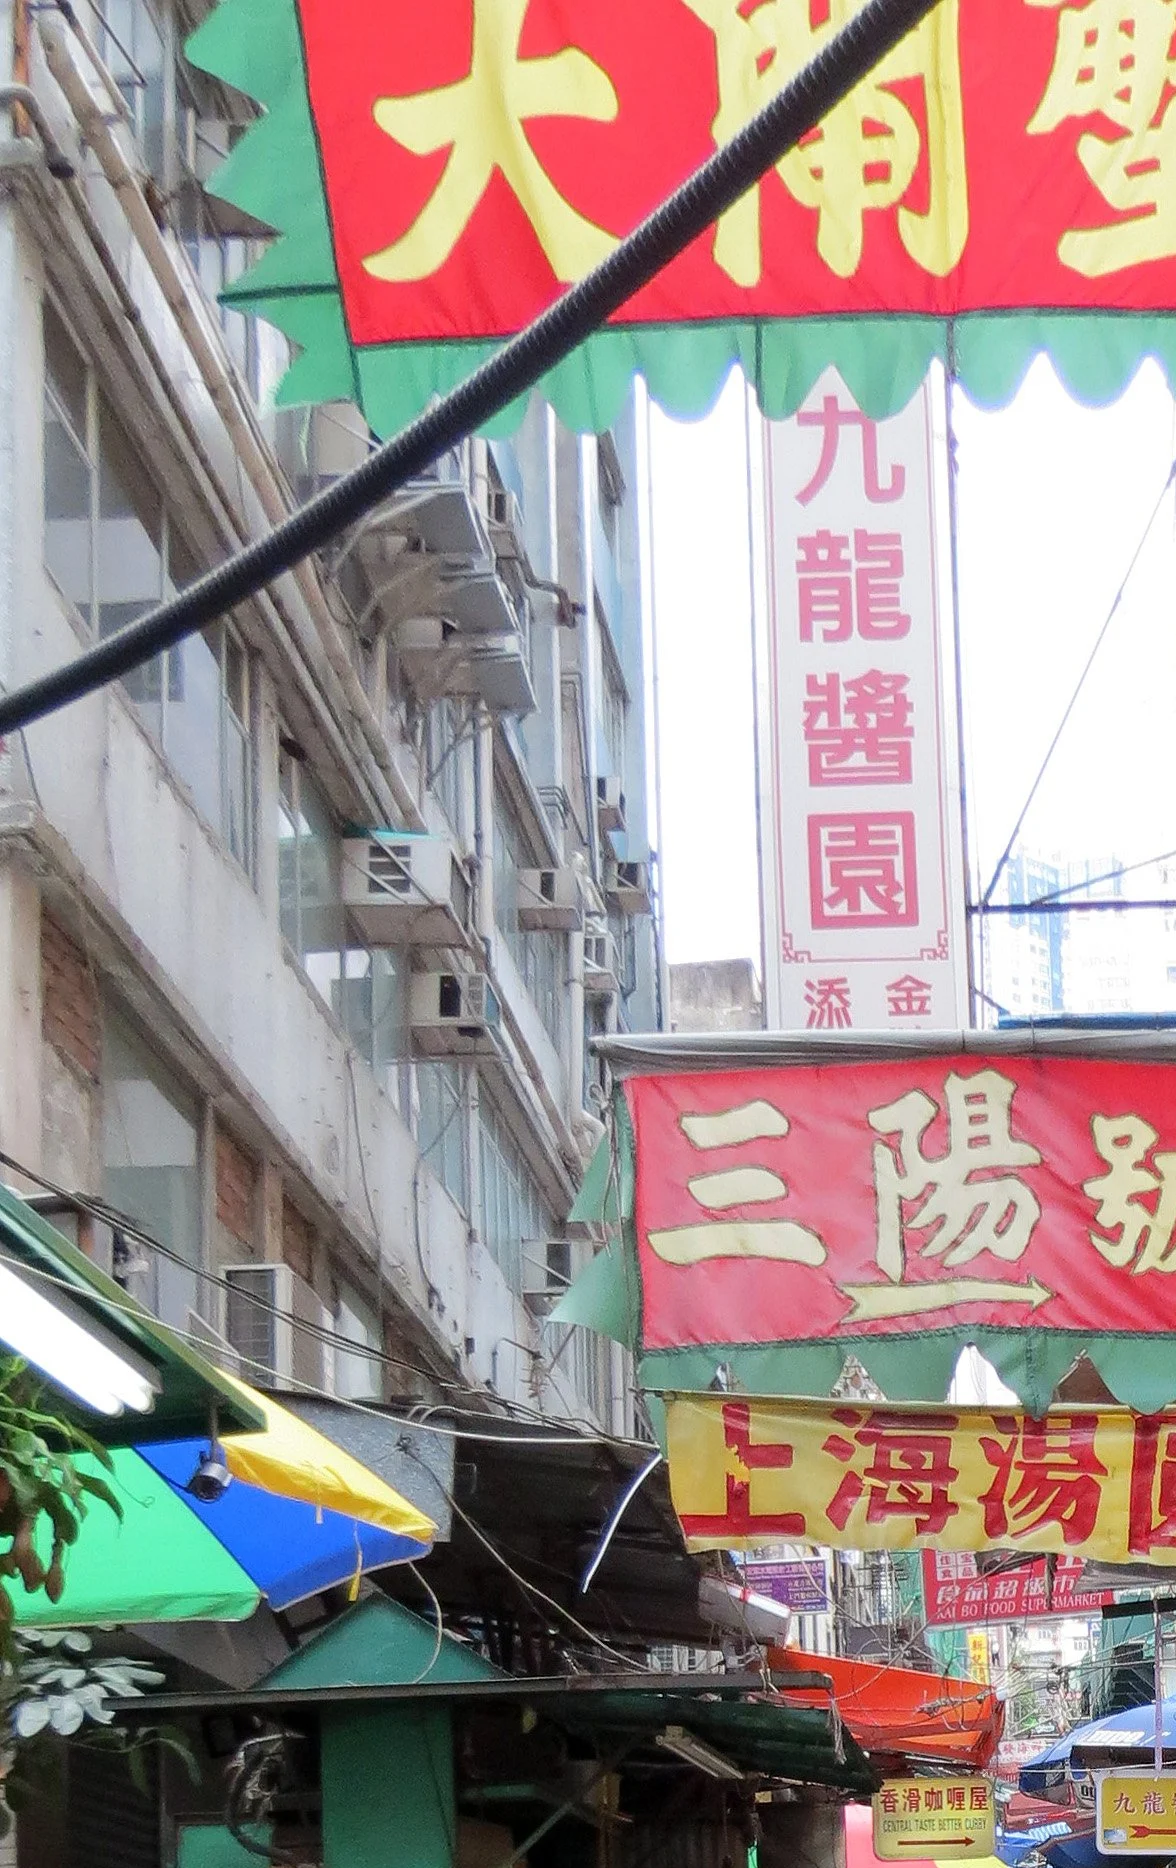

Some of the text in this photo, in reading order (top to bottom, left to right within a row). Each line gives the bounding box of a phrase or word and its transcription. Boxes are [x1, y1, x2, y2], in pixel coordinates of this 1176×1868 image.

[795, 395, 920, 931] 九龍醬園
[961, 1604, 979, 1617] BO
[984, 1601, 1017, 1615] FOOD
[880, 1786, 989, 1813] 香滑咖喱屋
[915, 1818, 936, 1832] TASTE
[939, 1818, 962, 1832] BETTER
[965, 1817, 987, 1831] CURRY
